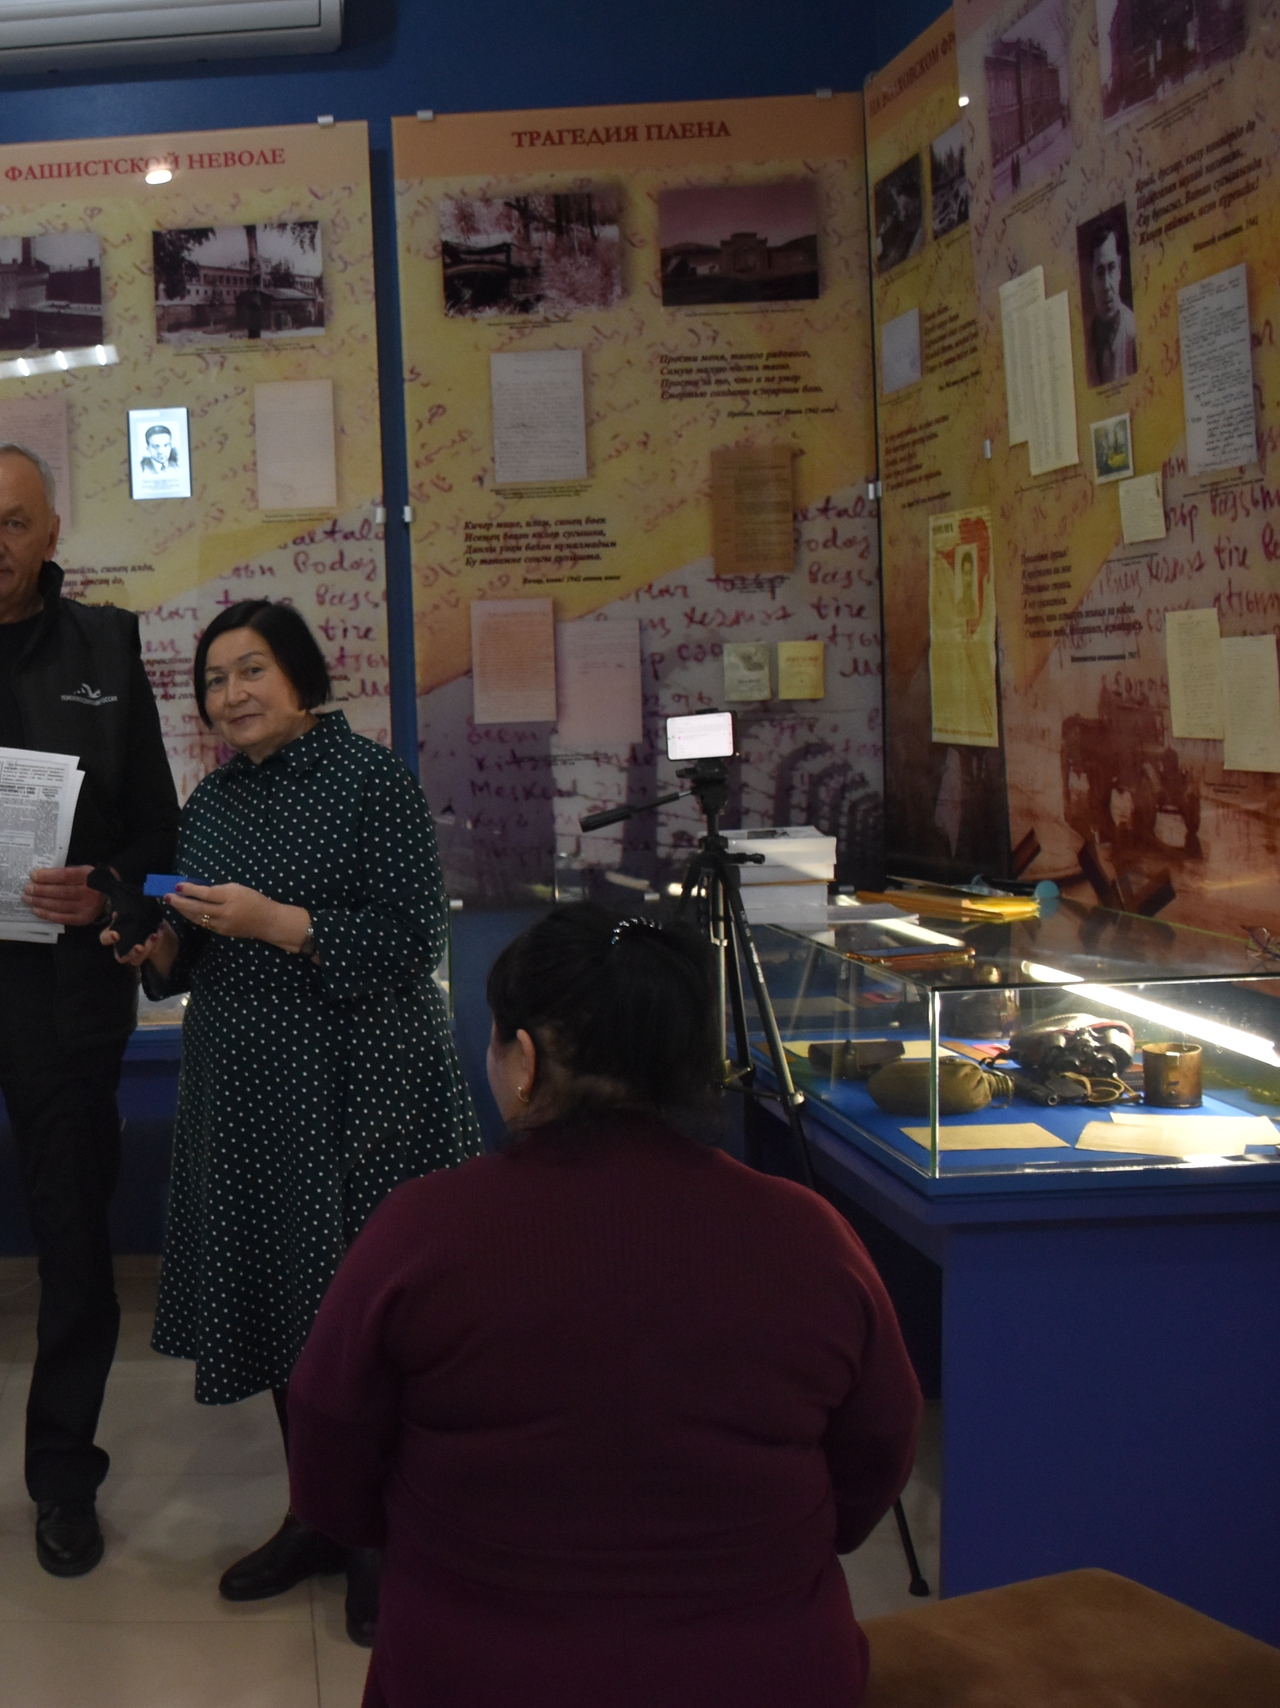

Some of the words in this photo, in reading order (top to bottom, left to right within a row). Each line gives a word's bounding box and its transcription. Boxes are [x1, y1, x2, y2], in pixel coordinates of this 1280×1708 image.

[511, 125, 639, 148] ТРАГЕДИЯ
[644, 119, 733, 142] ПЛЕНА
[4, 151, 181, 182] ФАШИСТСКОЙ
[187, 147, 287, 171] НЕВОЛЕ
